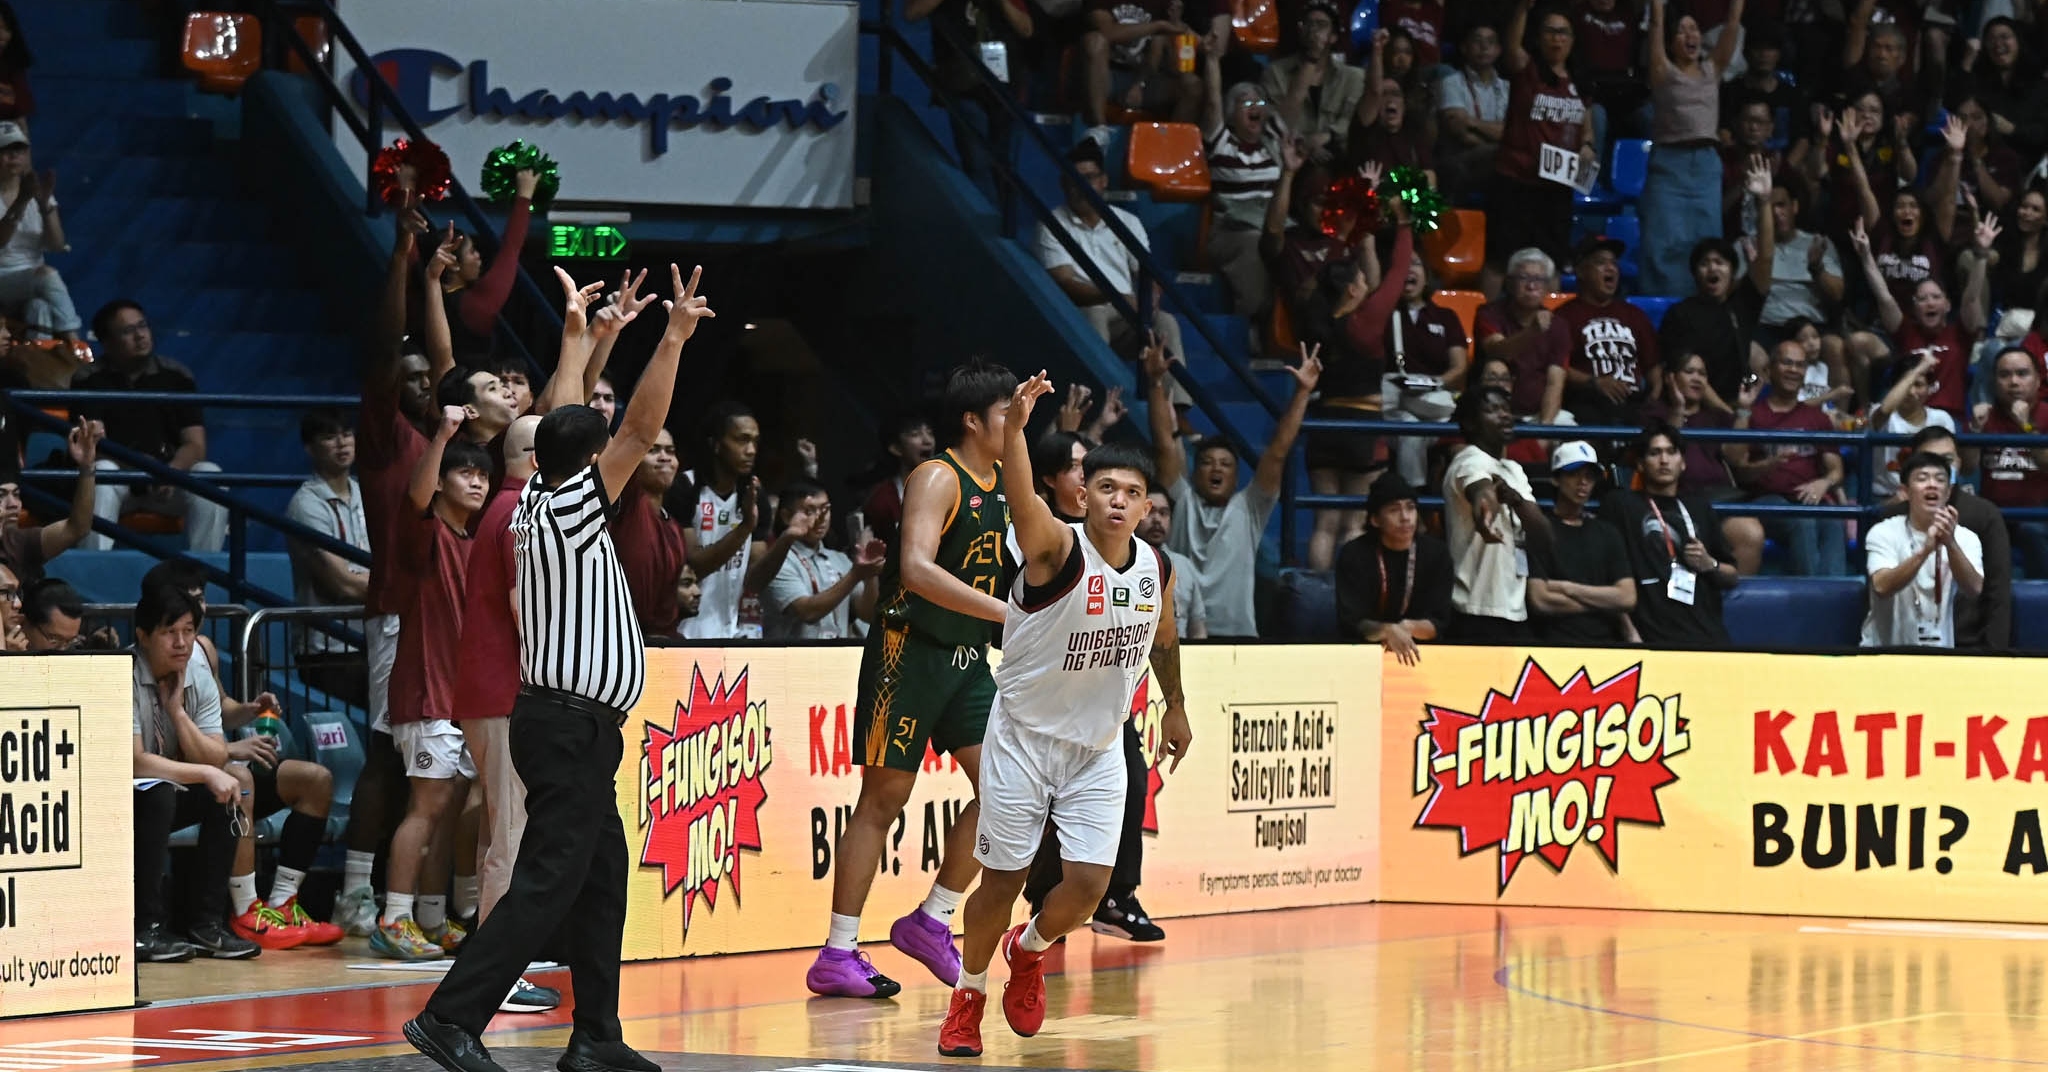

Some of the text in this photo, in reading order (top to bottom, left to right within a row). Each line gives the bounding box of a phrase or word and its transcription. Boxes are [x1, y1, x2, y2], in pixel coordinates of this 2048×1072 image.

[350, 48, 848, 155] Champion
[1543, 148, 1563, 176] UP
[551, 225, 611, 258] EXIT
[1089, 602, 1102, 610] BPI
[1063, 653, 1086, 671] NG
[896, 717, 917, 739] 51
[1232, 710, 1334, 753] Benzoic Acid+
[1415, 694, 1690, 794] I-FUNGISOL
[1754, 710, 2048, 783] KATI-KA
[639, 700, 772, 827] I-FUNGISOL
[1232, 756, 1331, 805] Salicylic Acid
[1256, 812, 1307, 851] Fungisol
[1506, 776, 1613, 854] MO!
[687, 799, 738, 891] MO!
[1753, 802, 1969, 875] BUNI?
[1206, 870, 1250, 896] symptoms
[1252, 869, 1279, 892] persist
[1282, 866, 1312, 887] consult
[1314, 868, 1332, 888] your
[1335, 863, 1362, 882] doctor
[29, 958, 66, 987] your
[69, 951, 121, 978] doctor
